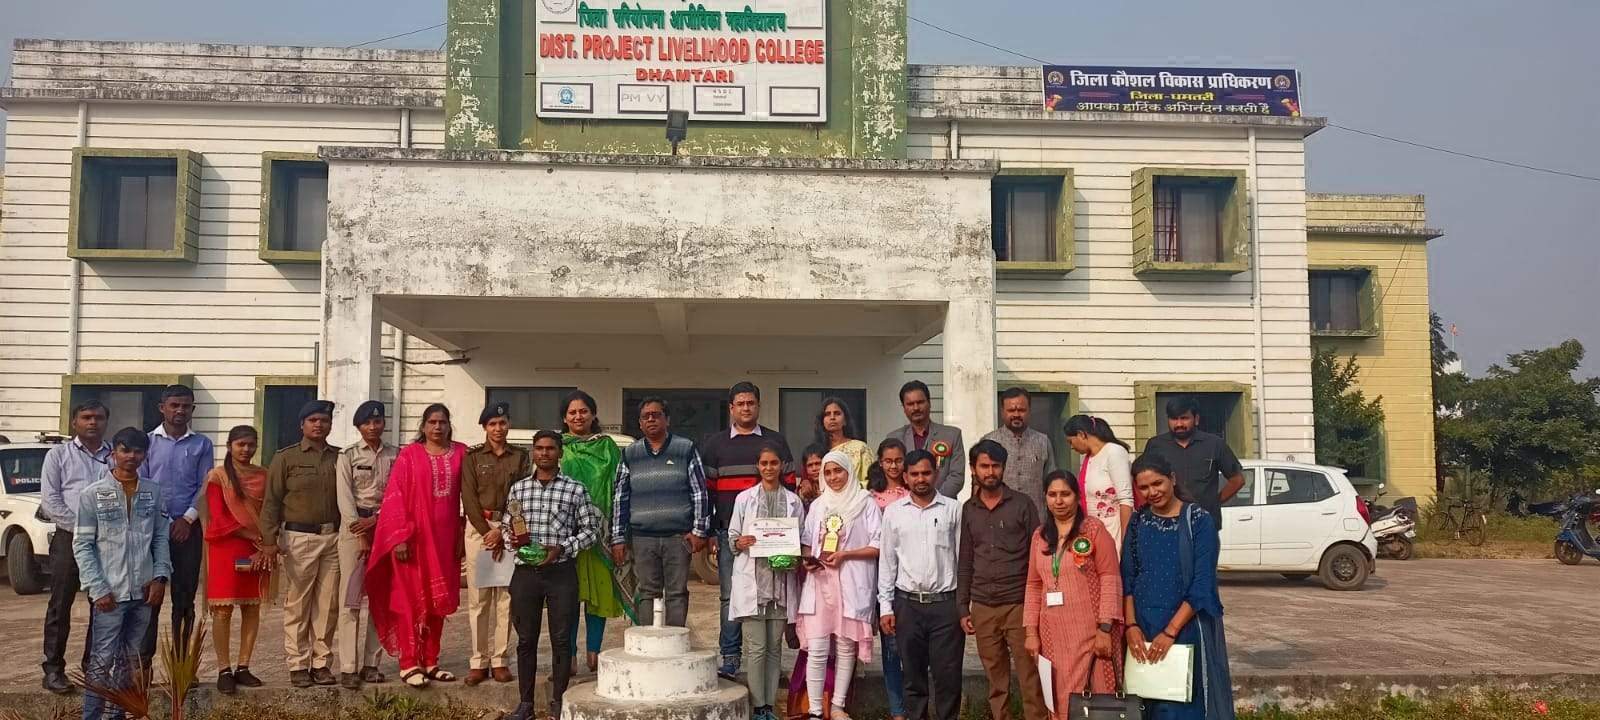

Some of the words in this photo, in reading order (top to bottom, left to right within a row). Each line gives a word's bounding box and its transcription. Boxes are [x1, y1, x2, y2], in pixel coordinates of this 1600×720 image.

[578, 1, 608, 28] जिला
[612, 2, 665, 29] परियोजना
[540, 33, 578, 59] DIST.
[583, 34, 654, 61] PROJECT
[658, 36, 751, 63] LIVELIHOOD
[755, 38, 824, 64] COLLEGE
[636, 67, 735, 83] DHAMTARI
[1070, 70, 1108, 86] जिला
[1110, 70, 1156, 87] कौशल
[1159, 71, 1204, 88] विकास
[1207, 72, 1272, 89] प्राधिकरण
[1076, 102, 1120, 112] आपका
[1122, 101, 1161, 112] हार्दिक
[1225, 102, 1257, 113] करती
[15, 477, 41, 485] POLIC
